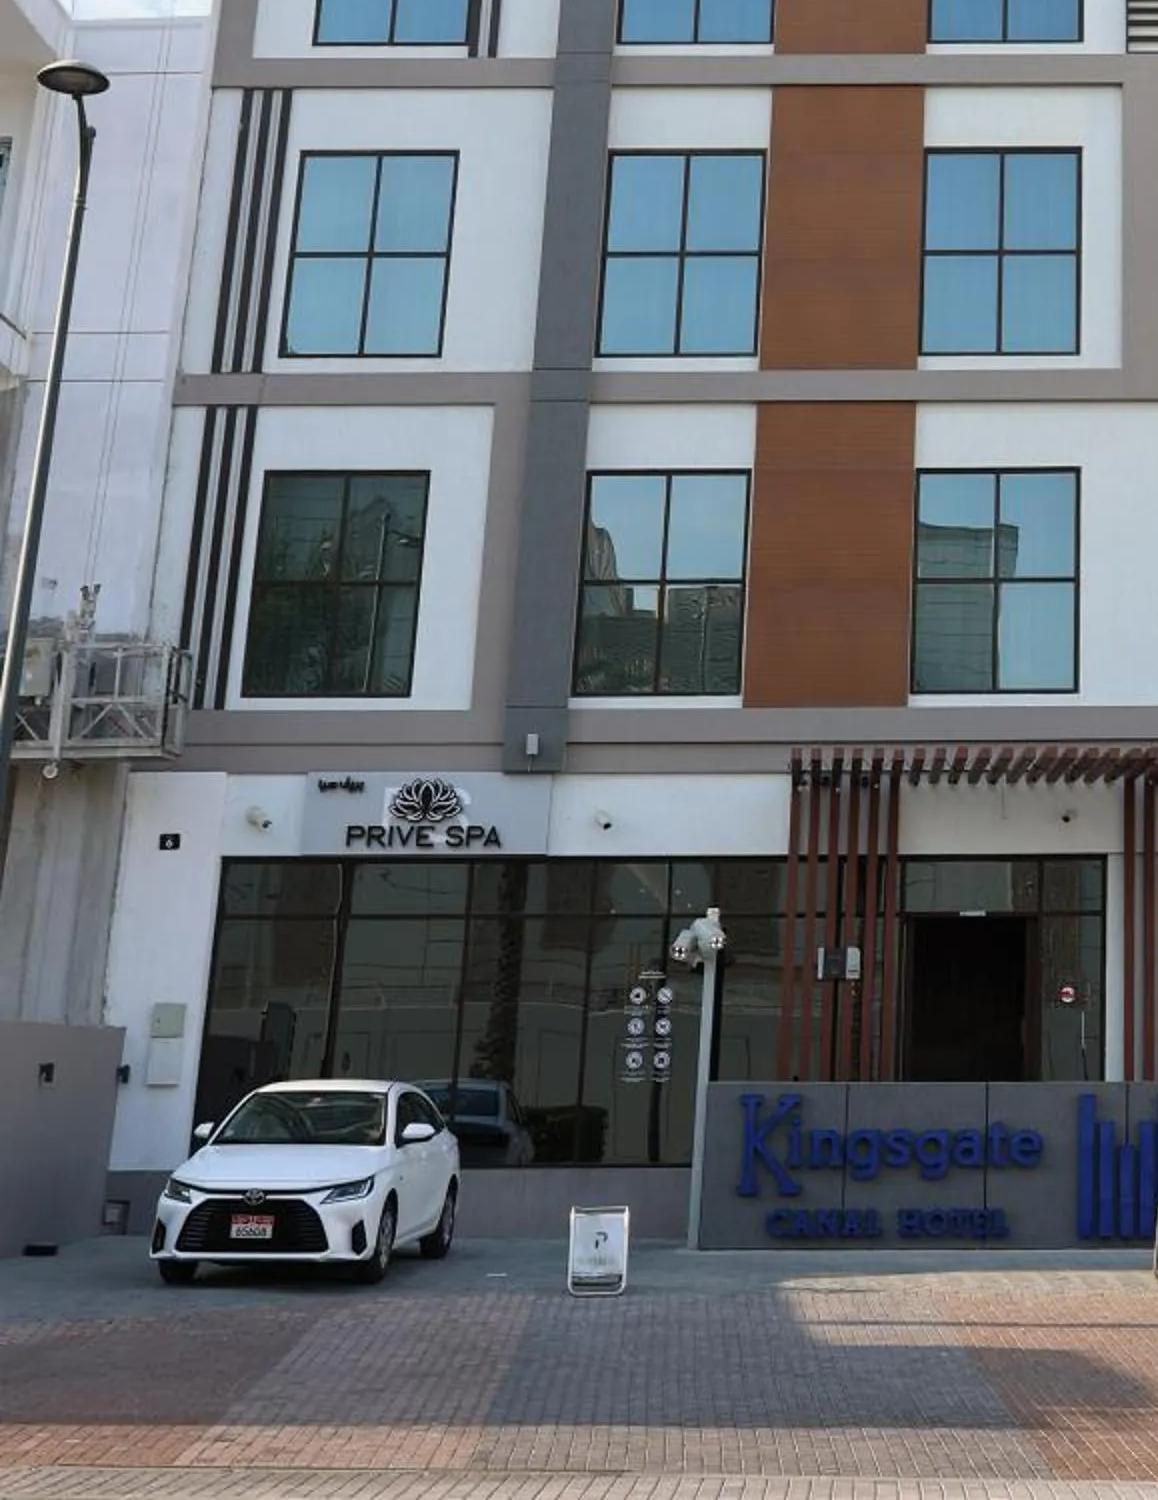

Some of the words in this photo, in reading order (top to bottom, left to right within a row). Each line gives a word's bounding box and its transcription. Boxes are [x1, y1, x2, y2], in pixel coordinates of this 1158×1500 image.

[345, 825, 435, 848] PRIVE
[445, 825, 503, 848] SPA
[736, 1093, 1046, 1197] Kingsgate
[766, 1208, 884, 1239] CANAL
[897, 1208, 1010, 1239] HOTEL
